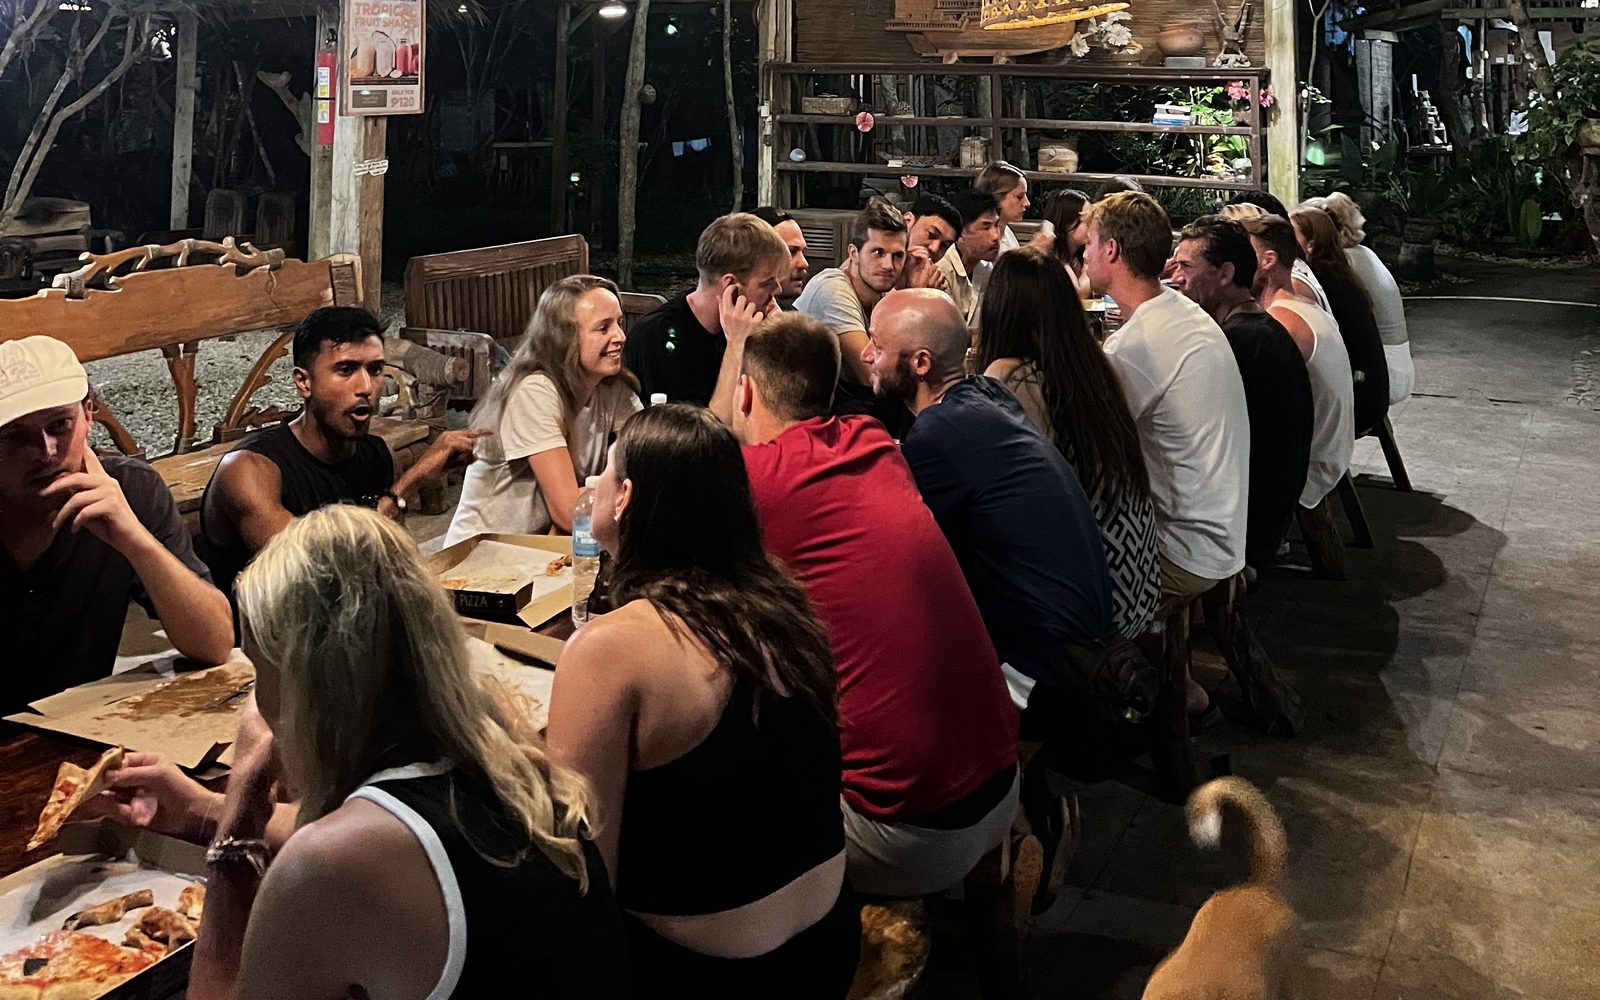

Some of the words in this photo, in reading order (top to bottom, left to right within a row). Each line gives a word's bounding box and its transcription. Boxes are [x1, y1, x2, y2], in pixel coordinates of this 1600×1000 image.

[355, 2, 417, 17] TROPICAL
[355, 17, 381, 27] FRUIT
[459, 594, 488, 608] PIZZA
